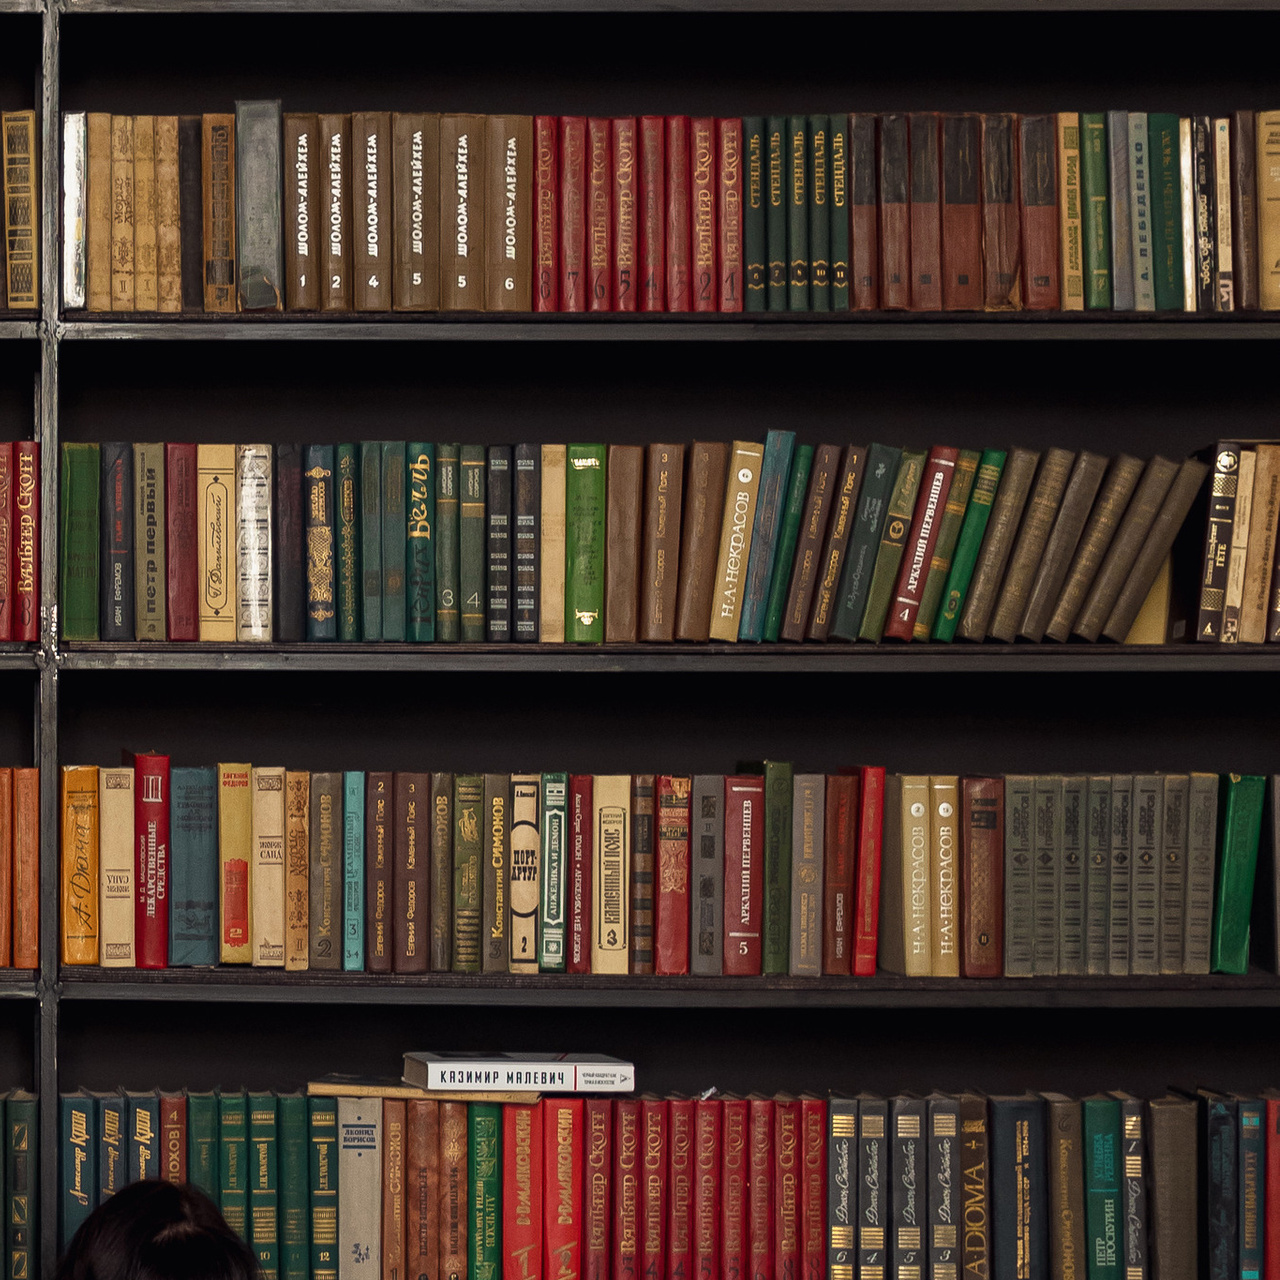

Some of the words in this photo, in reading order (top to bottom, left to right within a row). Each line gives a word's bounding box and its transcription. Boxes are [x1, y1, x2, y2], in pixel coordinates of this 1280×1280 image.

[296, 133, 309, 256] ШОЛОМ-АЛЕЙХЕМ
[366, 134, 379, 256] ШОЛОМ-АЛЕЙХЕМ
[750, 134, 761, 209] СТЕНДАЛЬ
[833, 133, 845, 208] СТЕНДАЛЬ
[505, 137, 517, 260] ШОЛОМ-АЛЕЙХЕМ
[332, 276, 341, 288] 2
[368, 275, 379, 287] 4
[412, 272, 423, 286] 5
[143, 467, 158, 555] первый
[917, 471, 945, 539] ПЕРВЕНЦЕВ
[113, 562, 123, 601] ЕФРЕМОВ
[143, 560, 160, 614] петр
[906, 539, 929, 594] АРКАДИЙ
[114, 605, 123, 626] ИВАН
[492, 797, 504, 867] СИМОНОВ
[550, 818, 559, 850] ДЕМОН
[740, 799, 753, 870] ПЕРВЕНЦЕВ
[146, 821, 158, 918] ЛЕКАРСТВЕННЫЕ
[157, 843, 166, 899] СРЕДСТВА
[511, 863, 537, 881] АРТУР
[549, 862, 559, 915] АНЖЕЛИКА
[492, 869, 503, 939] Константин
[740, 871, 752, 925] АРКАДИЙ
[520, 936, 527, 954] 2
[738, 941, 749, 955] 5
[440, 1070, 500, 1086] КАЗИМИР
[507, 1069, 566, 1085] МАЛЕВИЧ
[70, 1110, 88, 1144] КРОН
[343, 1128, 376, 1136] ЛЕОНИД
[343, 1136, 376, 1144] БОРИСОВ
[589, 1110, 606, 1168] СКОТТ
[588, 1172, 607, 1250] ВАЛЬТЕР
[1104, 1199, 1116, 1266] ПРОСКУРИН
[1095, 1237, 1106, 1266] ПЕТР
